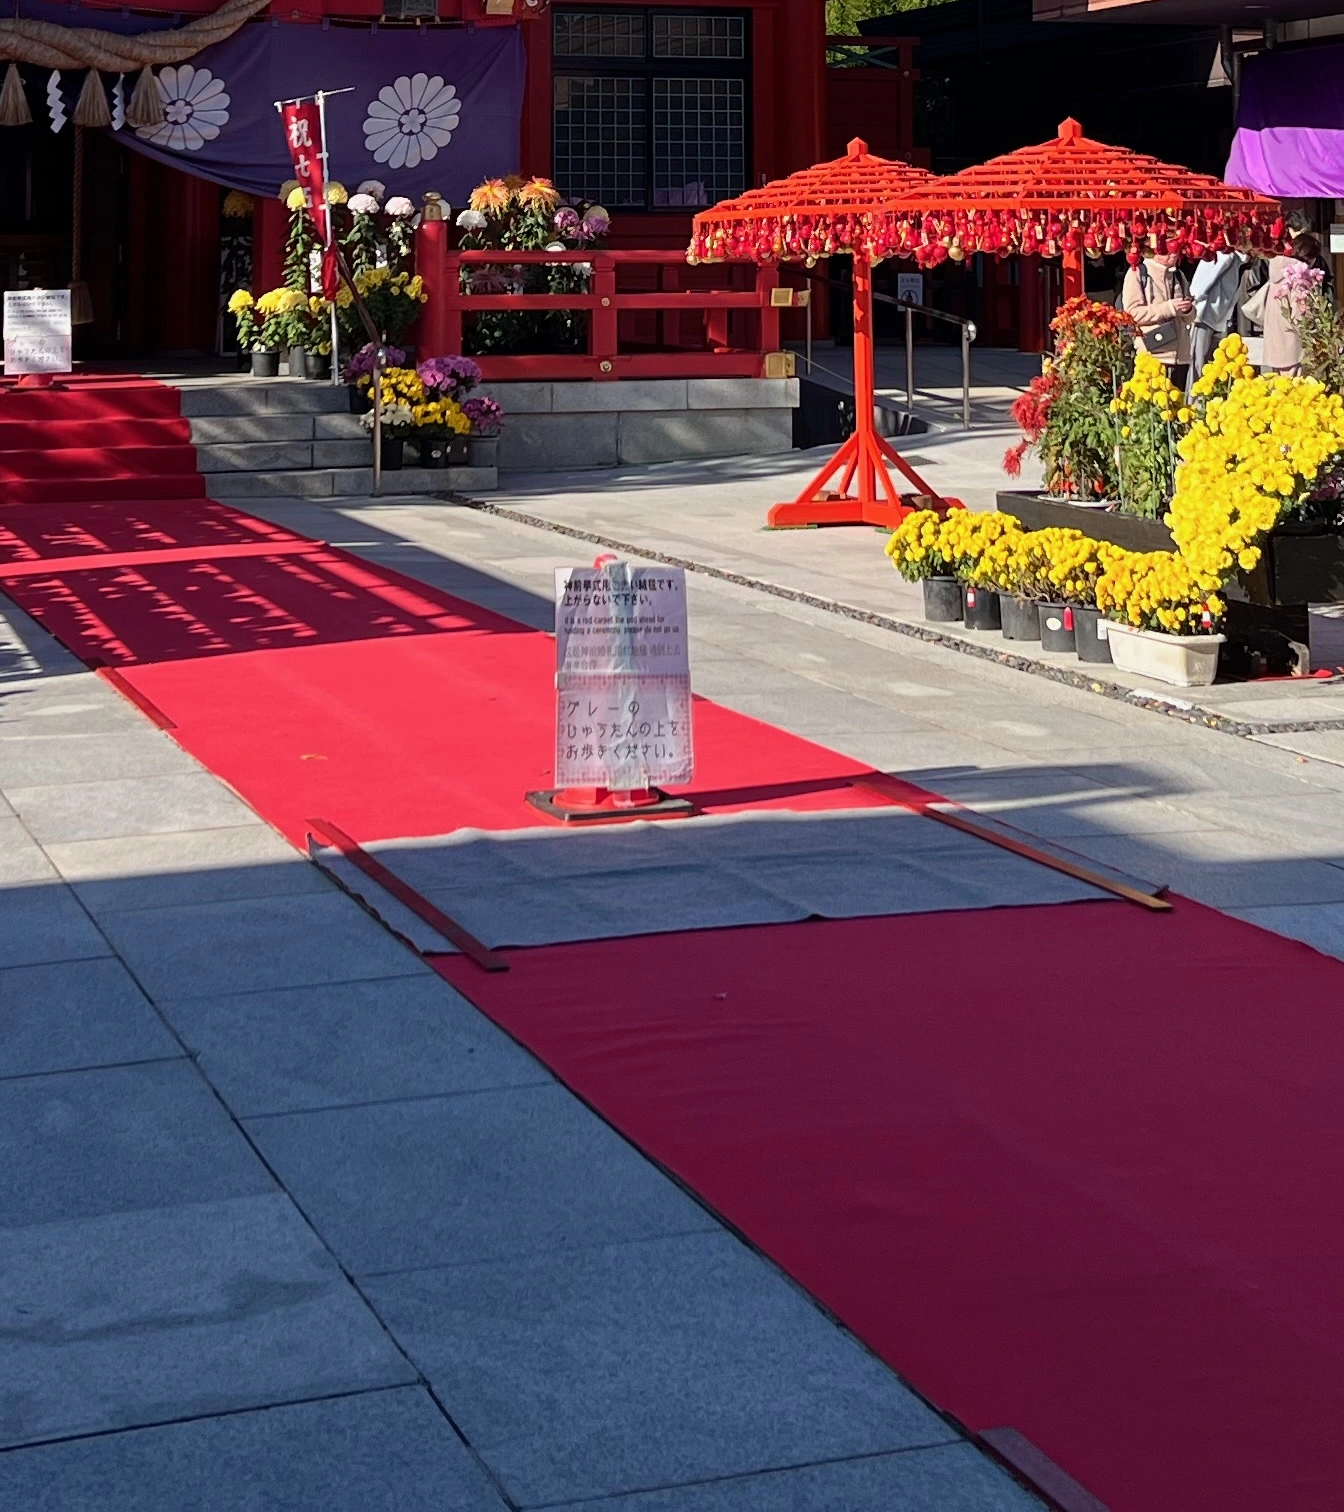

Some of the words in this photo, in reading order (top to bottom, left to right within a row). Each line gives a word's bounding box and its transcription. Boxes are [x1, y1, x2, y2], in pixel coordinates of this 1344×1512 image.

[564, 593, 653, 606] 上がらないで下さい。
[567, 720, 679, 739] じゅうたんの上を
[566, 743, 674, 761] お歩きください。
